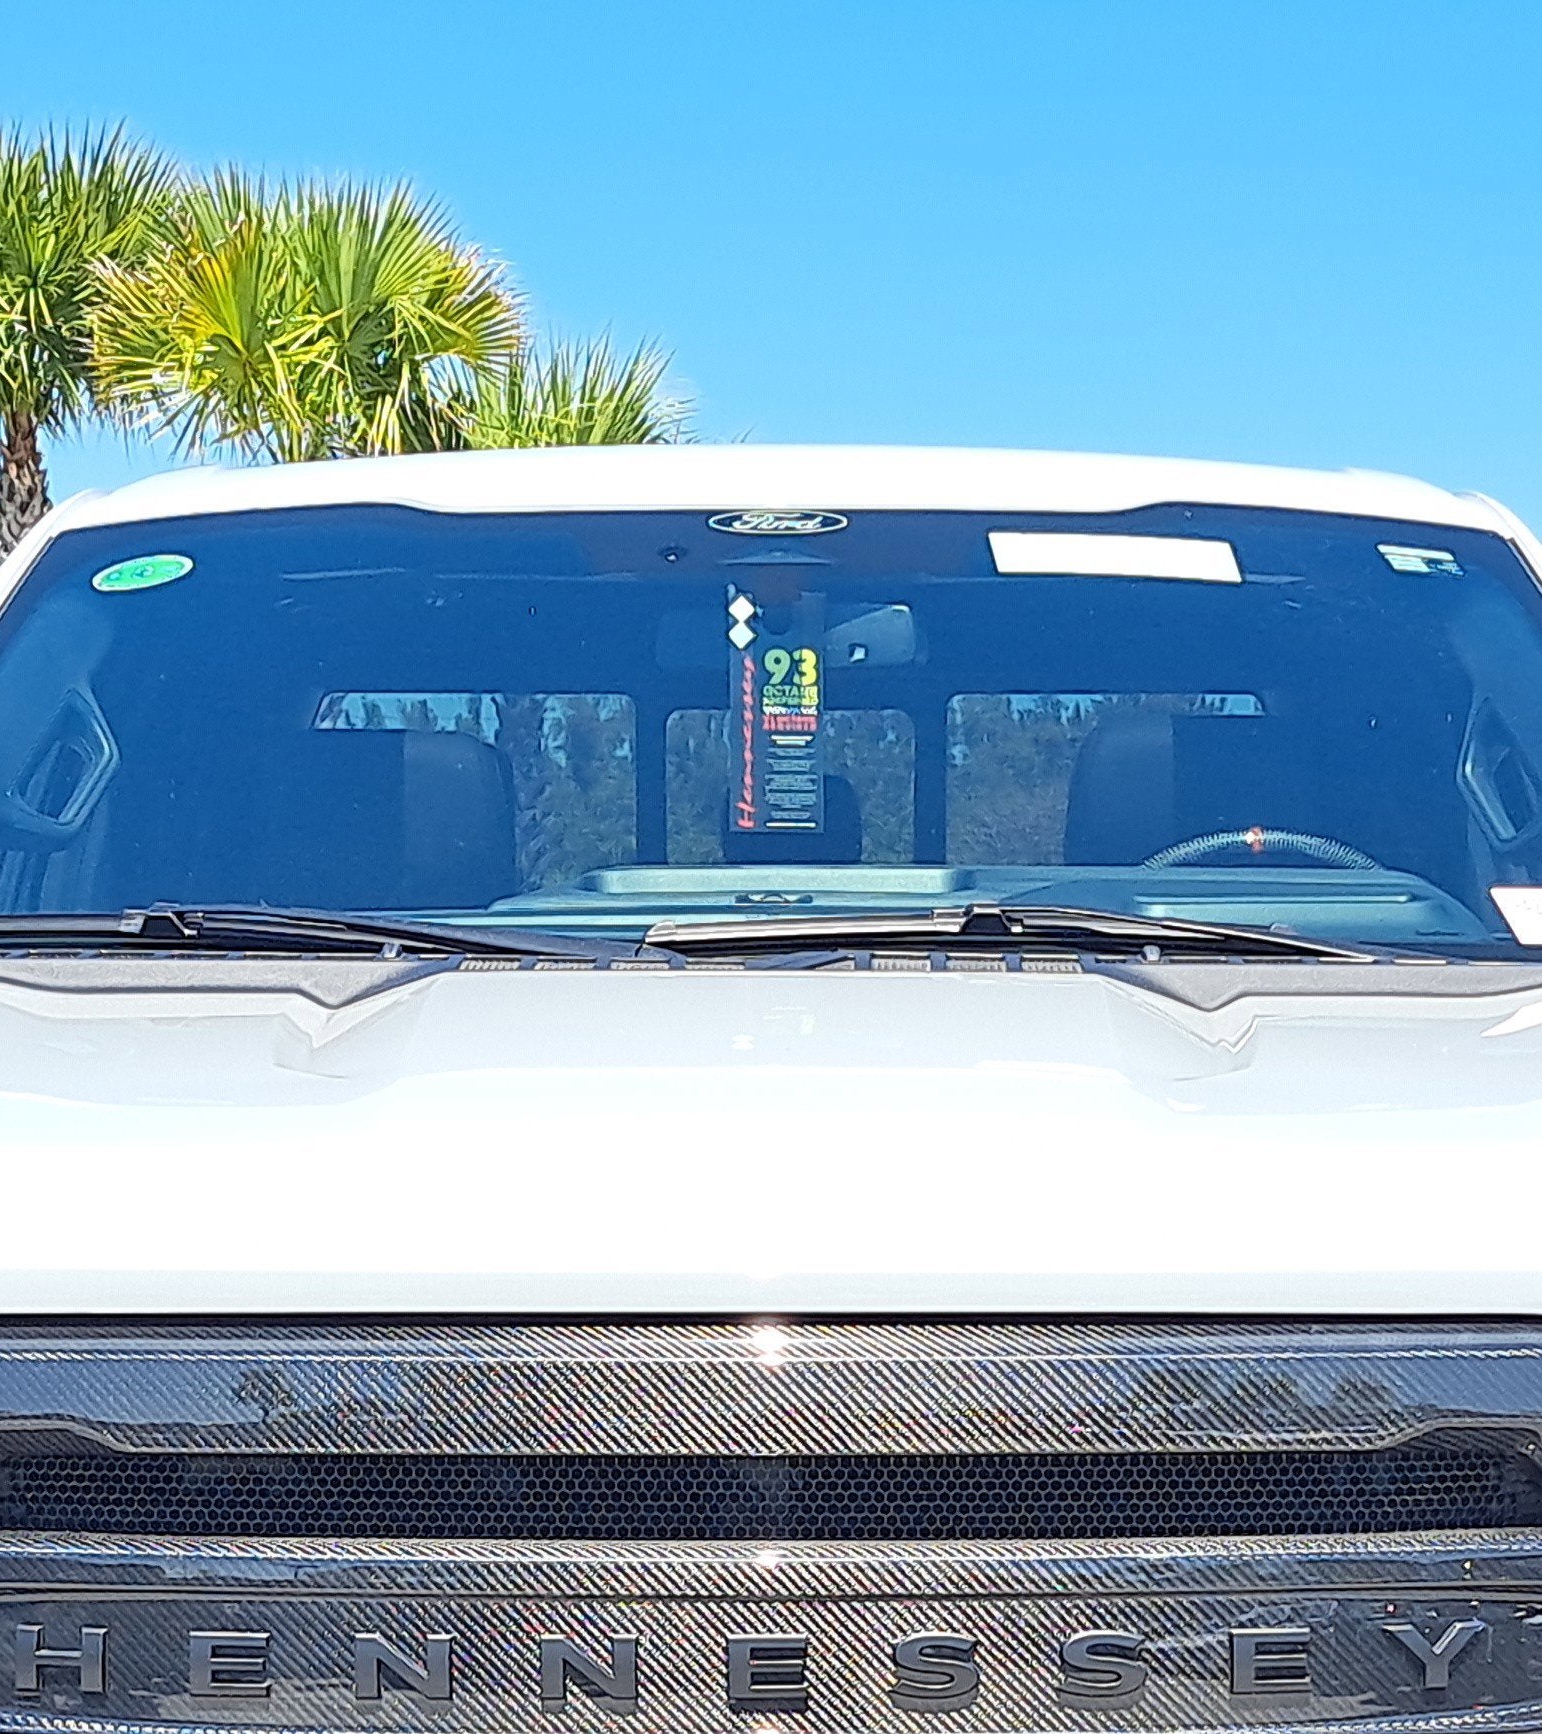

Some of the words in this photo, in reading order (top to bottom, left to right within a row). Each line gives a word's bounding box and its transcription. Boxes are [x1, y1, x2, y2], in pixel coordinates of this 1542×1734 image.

[731, 512, 825, 530] Ford
[764, 648, 818, 686] 93
[14, 1619, 1487, 1702] HENNESSEY
